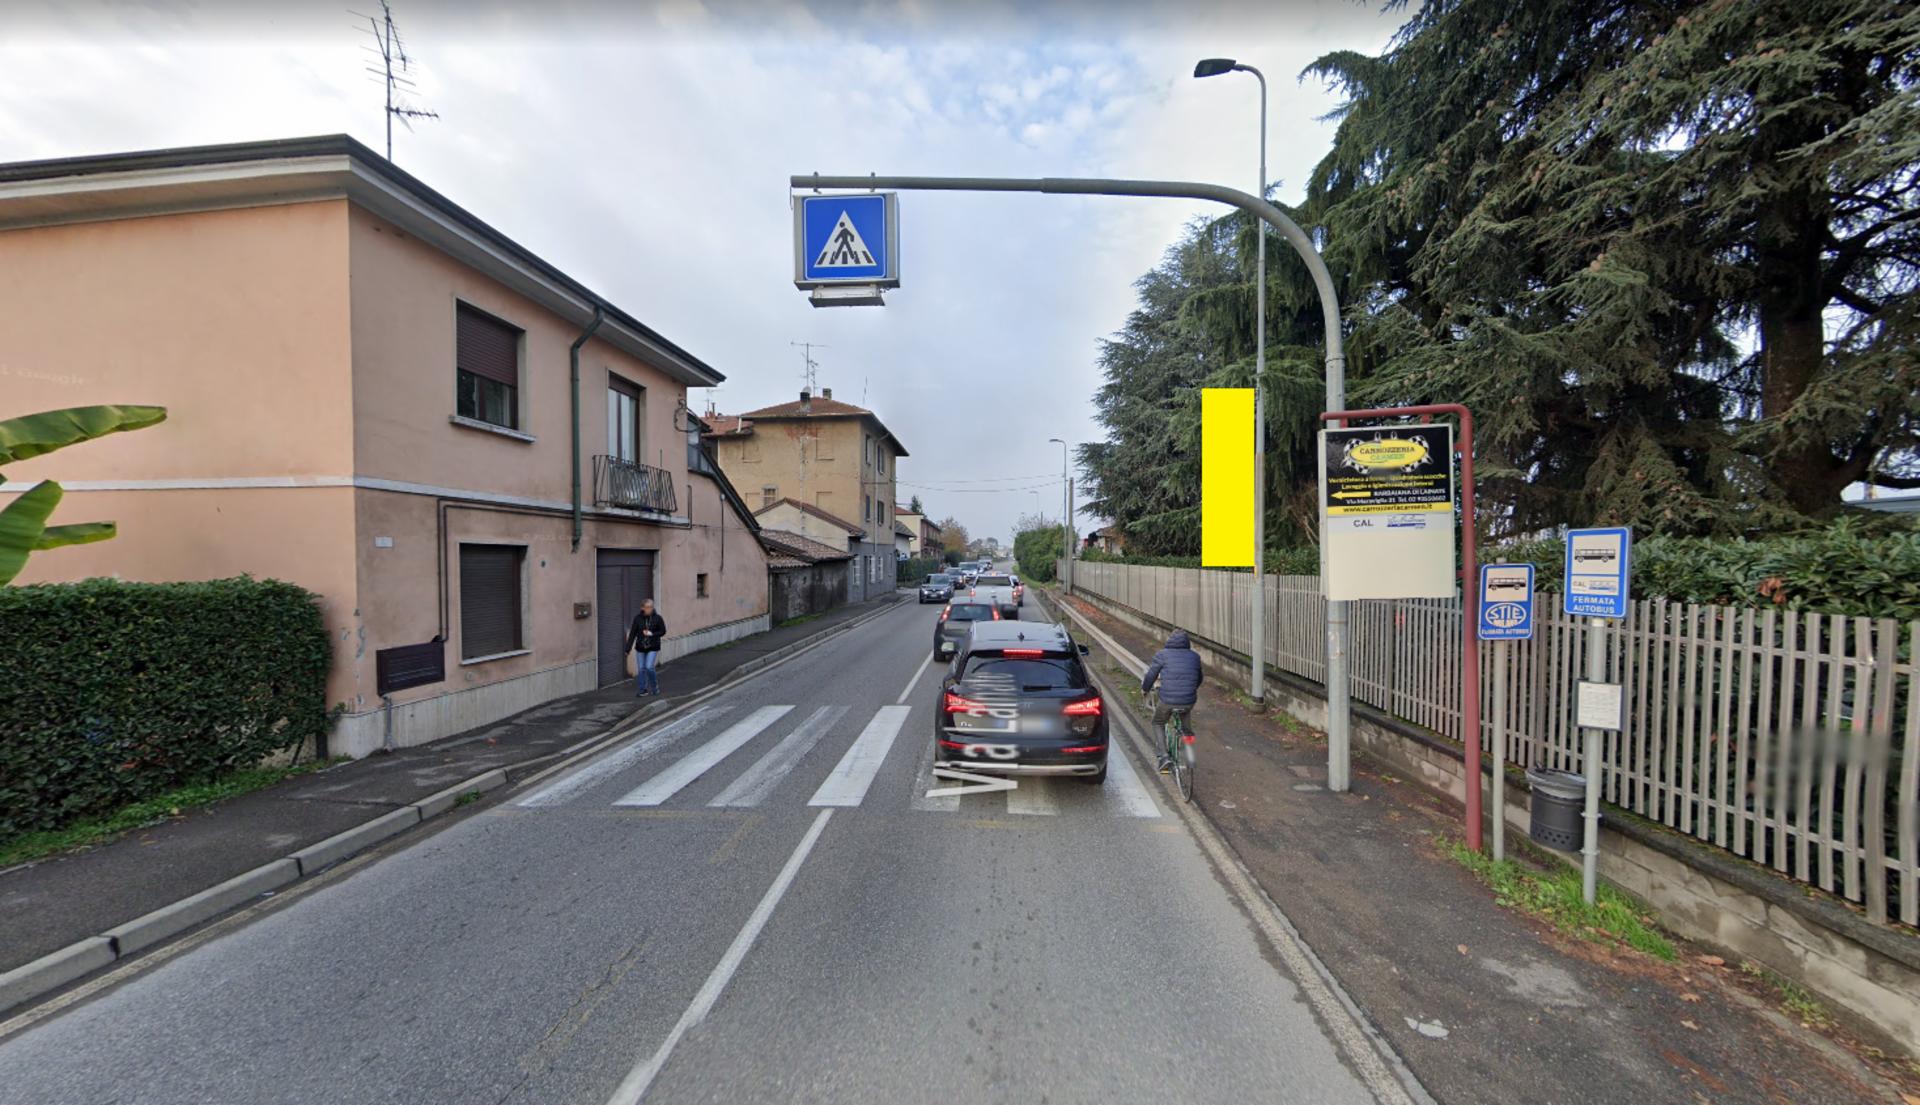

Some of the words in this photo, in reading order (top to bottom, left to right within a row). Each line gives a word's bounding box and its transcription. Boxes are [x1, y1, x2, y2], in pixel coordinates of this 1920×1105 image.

[1360, 446, 1415, 455] CARROZZERIA
[1353, 519, 1374, 527] CAL
[1573, 595, 1616, 605] FERMATA
[1488, 605, 1523, 620] STIE
[1574, 604, 1615, 613] AUTOBUS
